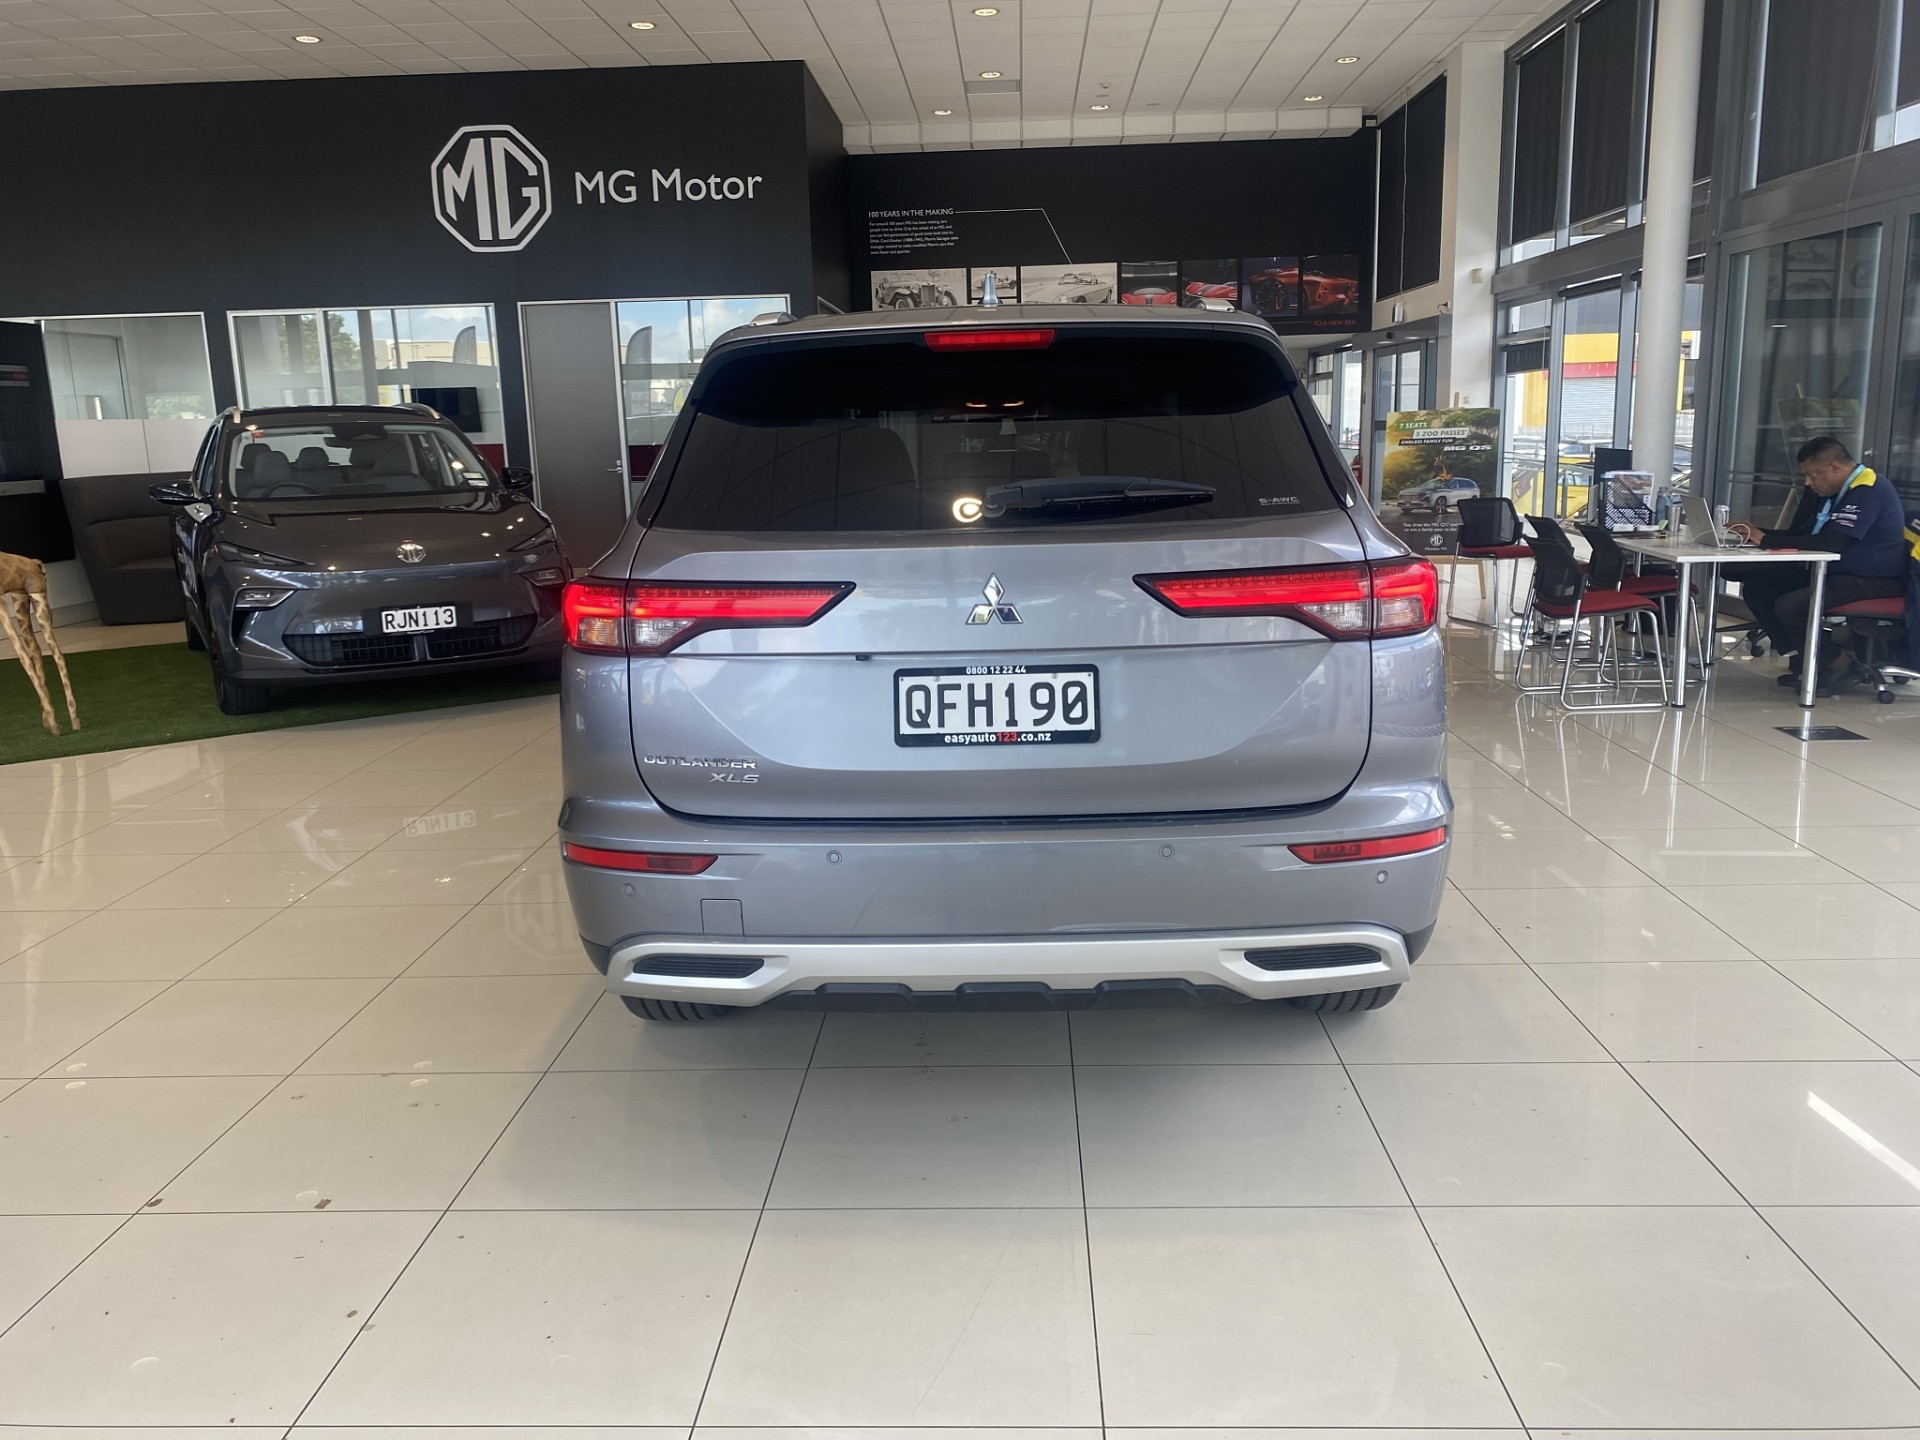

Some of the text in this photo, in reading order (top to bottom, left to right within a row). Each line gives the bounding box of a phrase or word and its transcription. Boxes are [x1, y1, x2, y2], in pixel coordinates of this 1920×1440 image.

[442, 137, 541, 241] MG
[574, 168, 763, 205] MG Motor
[879, 210, 901, 218] YEARS
[925, 208, 954, 216] MAKING
[384, 608, 454, 631] RJN113
[966, 665, 1027, 675] 0800 12 22 44
[905, 680, 1089, 729] QFH190
[944, 731, 1052, 745] easyauto123.co.nz
[643, 754, 757, 769] OUTLANDER
[708, 772, 760, 784] XLS
